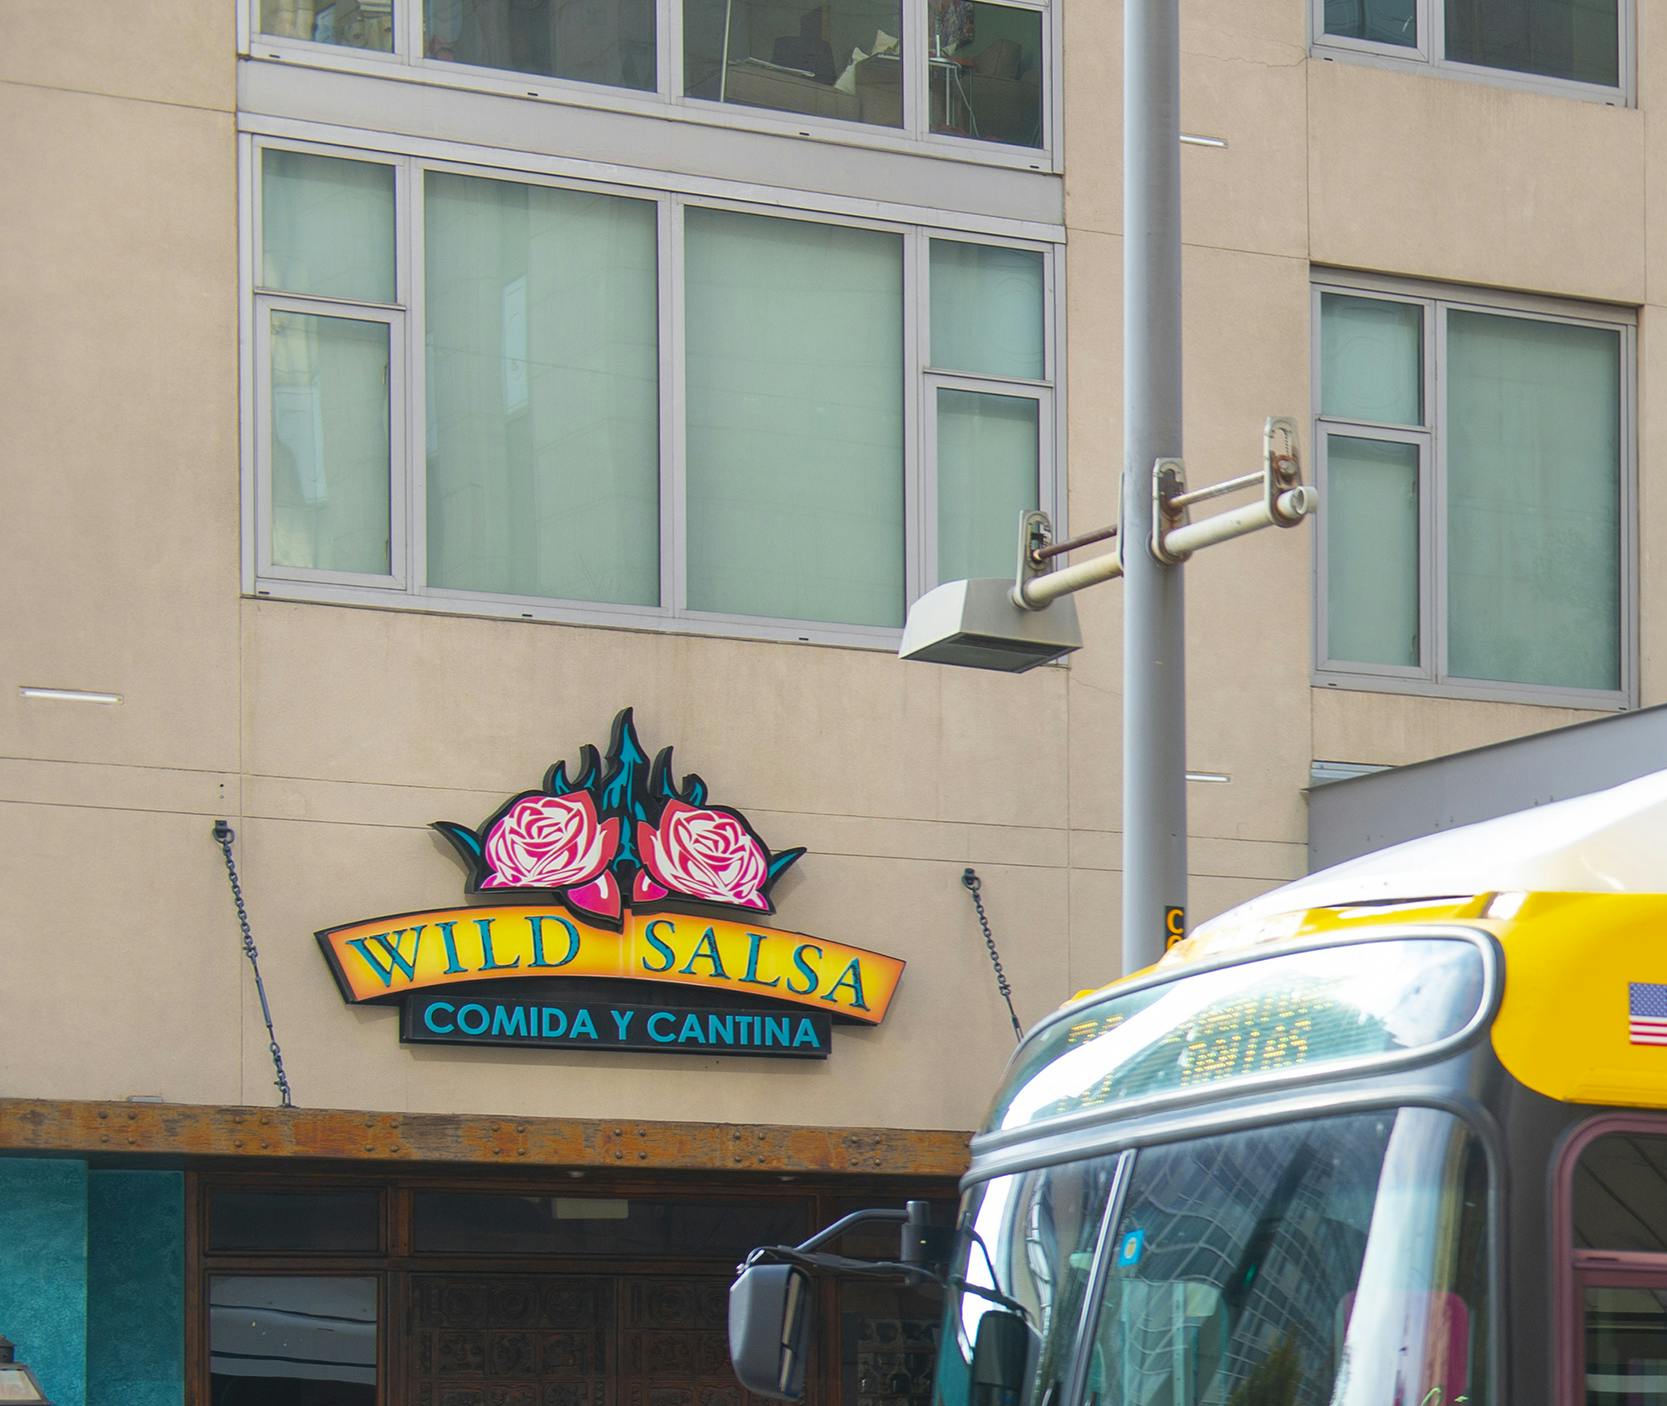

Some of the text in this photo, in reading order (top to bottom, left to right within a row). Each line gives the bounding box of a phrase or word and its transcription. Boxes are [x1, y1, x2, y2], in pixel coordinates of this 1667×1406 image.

[345, 913, 872, 1013] WILD SALSA
[423, 1000, 821, 1049] COMIDA Y CANTINA
